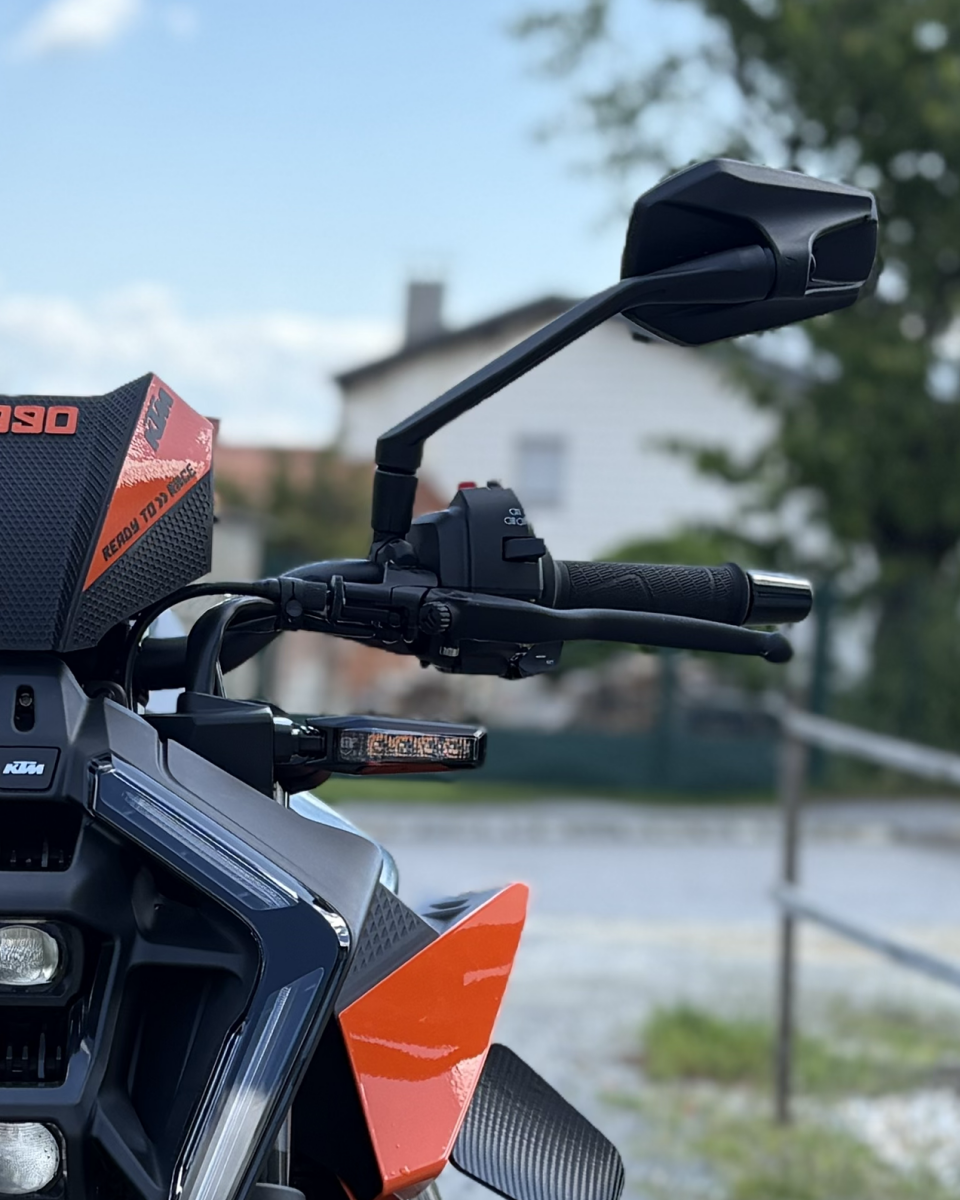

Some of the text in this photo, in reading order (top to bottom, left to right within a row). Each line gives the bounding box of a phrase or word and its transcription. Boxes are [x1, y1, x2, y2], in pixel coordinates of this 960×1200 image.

[143, 387, 174, 452] KTM
[102, 463, 197, 562] READY TO RACE
[2, 760, 46, 775] KTM
